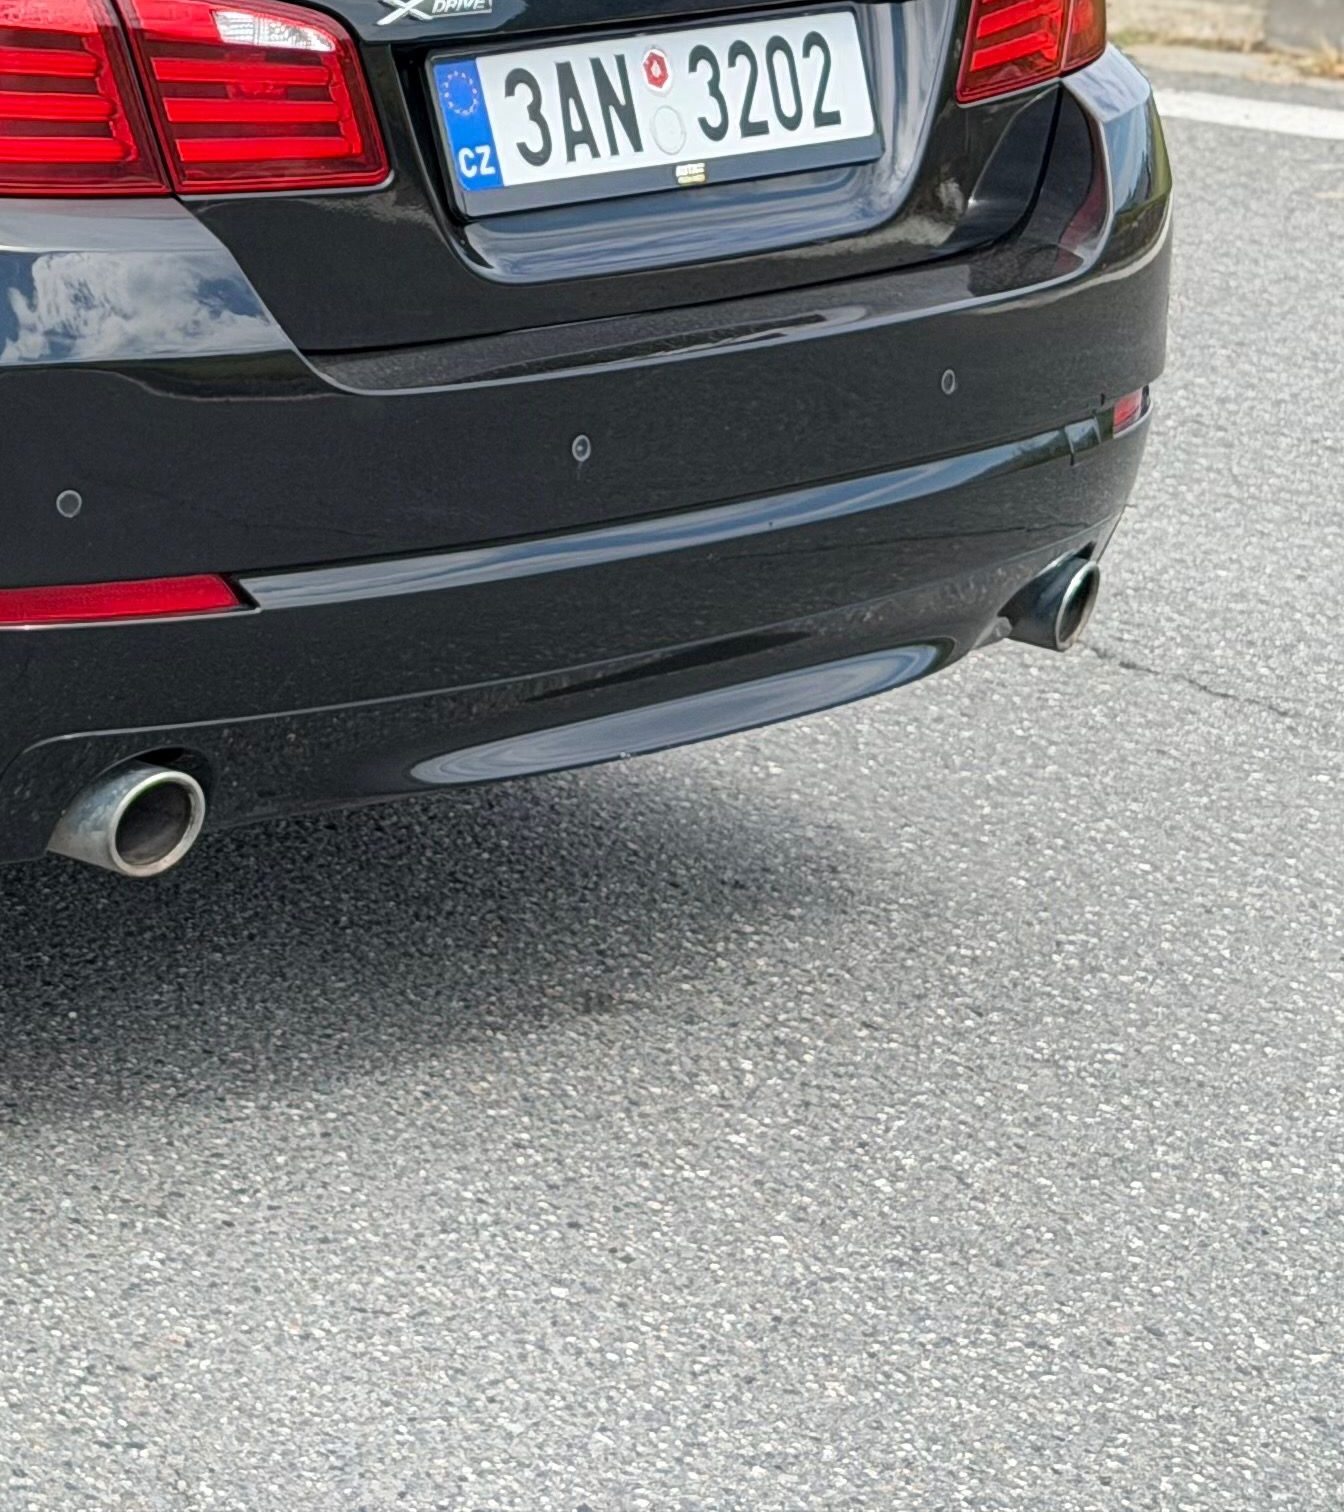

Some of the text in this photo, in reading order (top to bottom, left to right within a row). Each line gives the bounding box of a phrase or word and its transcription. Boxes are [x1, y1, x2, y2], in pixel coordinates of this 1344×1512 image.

[504, 30, 842, 168] 3AN 3202
[458, 144, 496, 178] CZ
